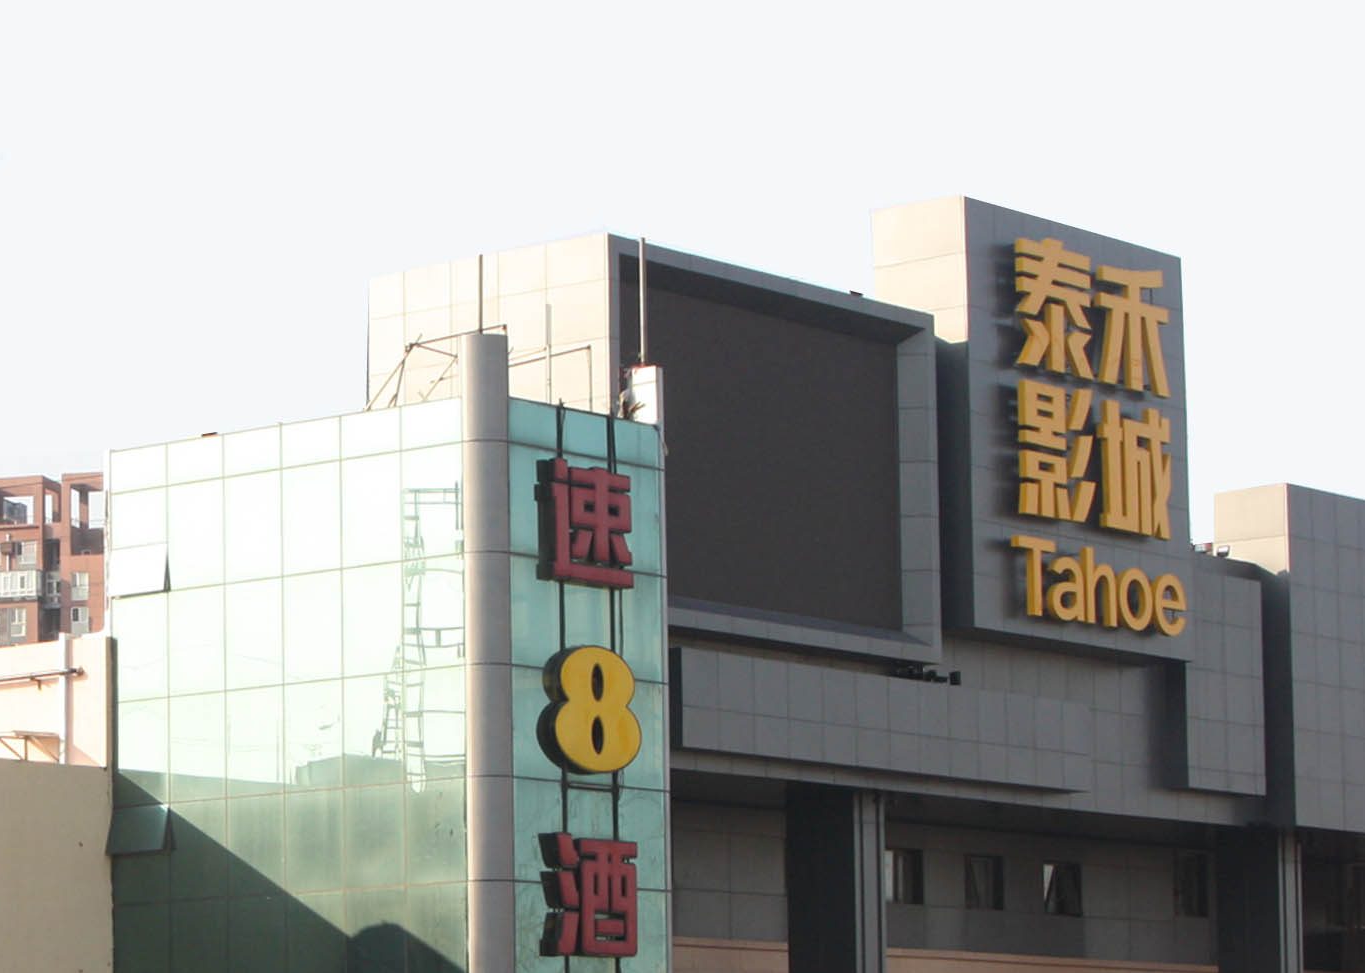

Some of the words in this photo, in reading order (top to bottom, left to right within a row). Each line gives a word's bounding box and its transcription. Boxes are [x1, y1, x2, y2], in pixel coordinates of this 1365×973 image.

[1015, 238, 1170, 398] 泰禾
[1018, 379, 1171, 540] 影城
[1011, 534, 1187, 636] Tahoe
